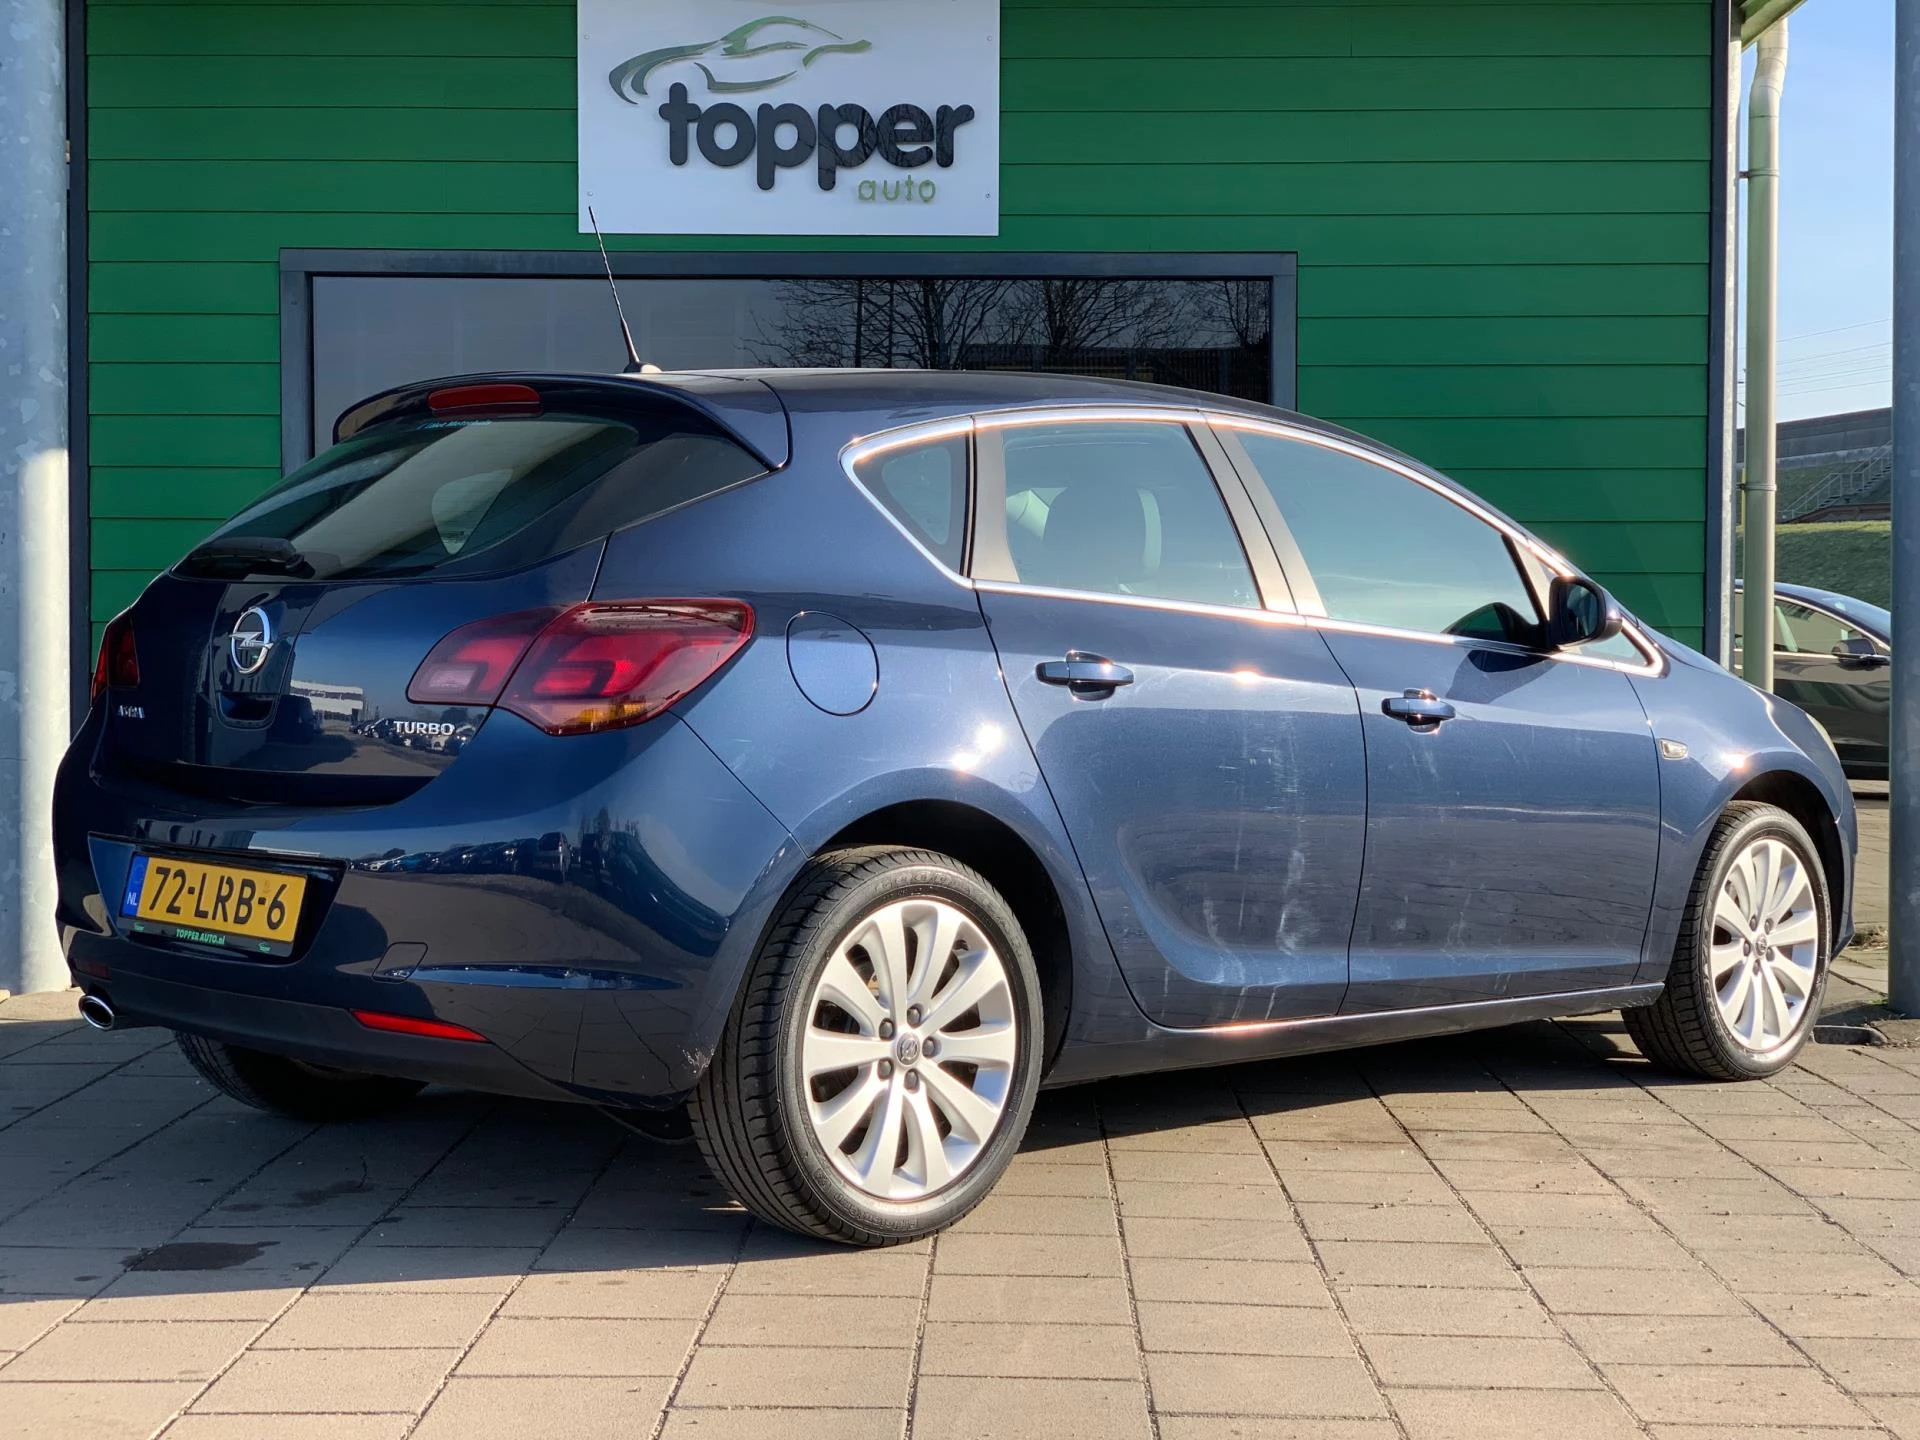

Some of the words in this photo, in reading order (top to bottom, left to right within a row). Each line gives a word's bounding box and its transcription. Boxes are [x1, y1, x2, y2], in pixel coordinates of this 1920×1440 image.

[659, 82, 975, 191] topper
[858, 174, 937, 203] auto
[393, 720, 455, 736] TURBO
[126, 891, 138, 906] NL
[148, 866, 288, 931] 72-LRB-6
[176, 928, 200, 941] TOPPER
